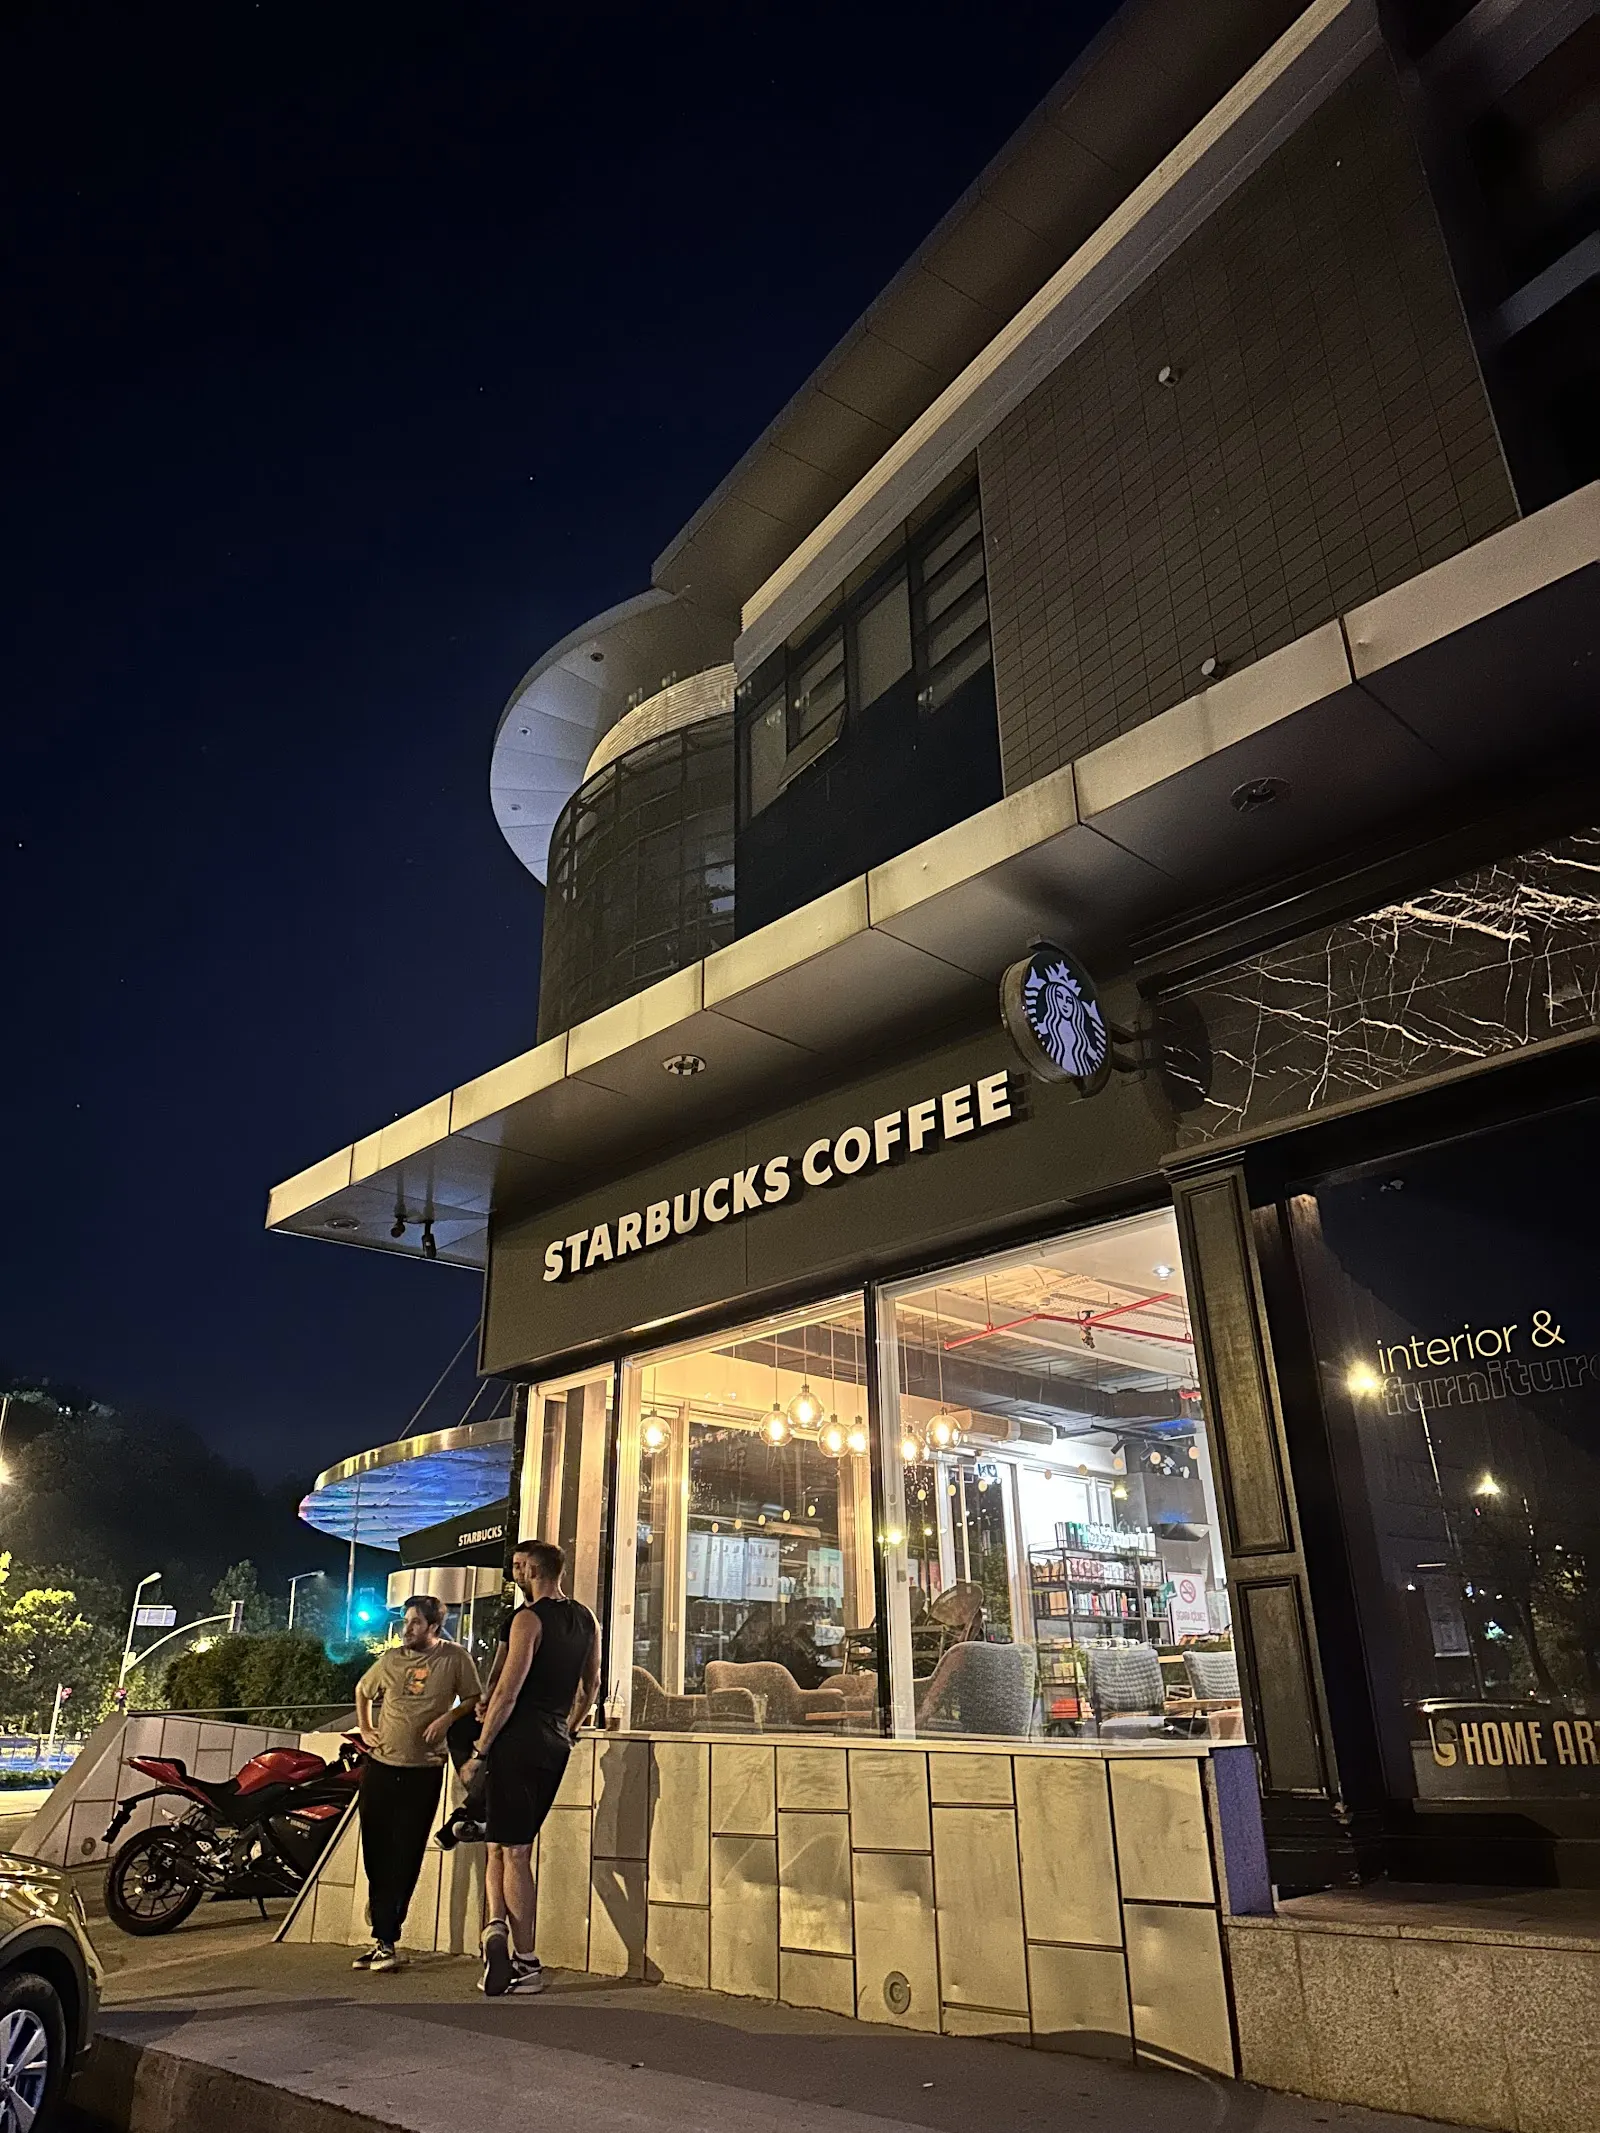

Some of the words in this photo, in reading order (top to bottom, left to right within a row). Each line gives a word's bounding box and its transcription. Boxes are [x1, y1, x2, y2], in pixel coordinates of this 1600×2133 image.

[542, 1156, 791, 1282] STARBUCKS
[802, 1069, 1012, 1186] COFFEE
[1376, 1323, 1518, 1375] interior
[1531, 1309, 1566, 1348] &
[458, 1525, 503, 1547] STARBUCKS
[1460, 1721, 1548, 1766] HOME
